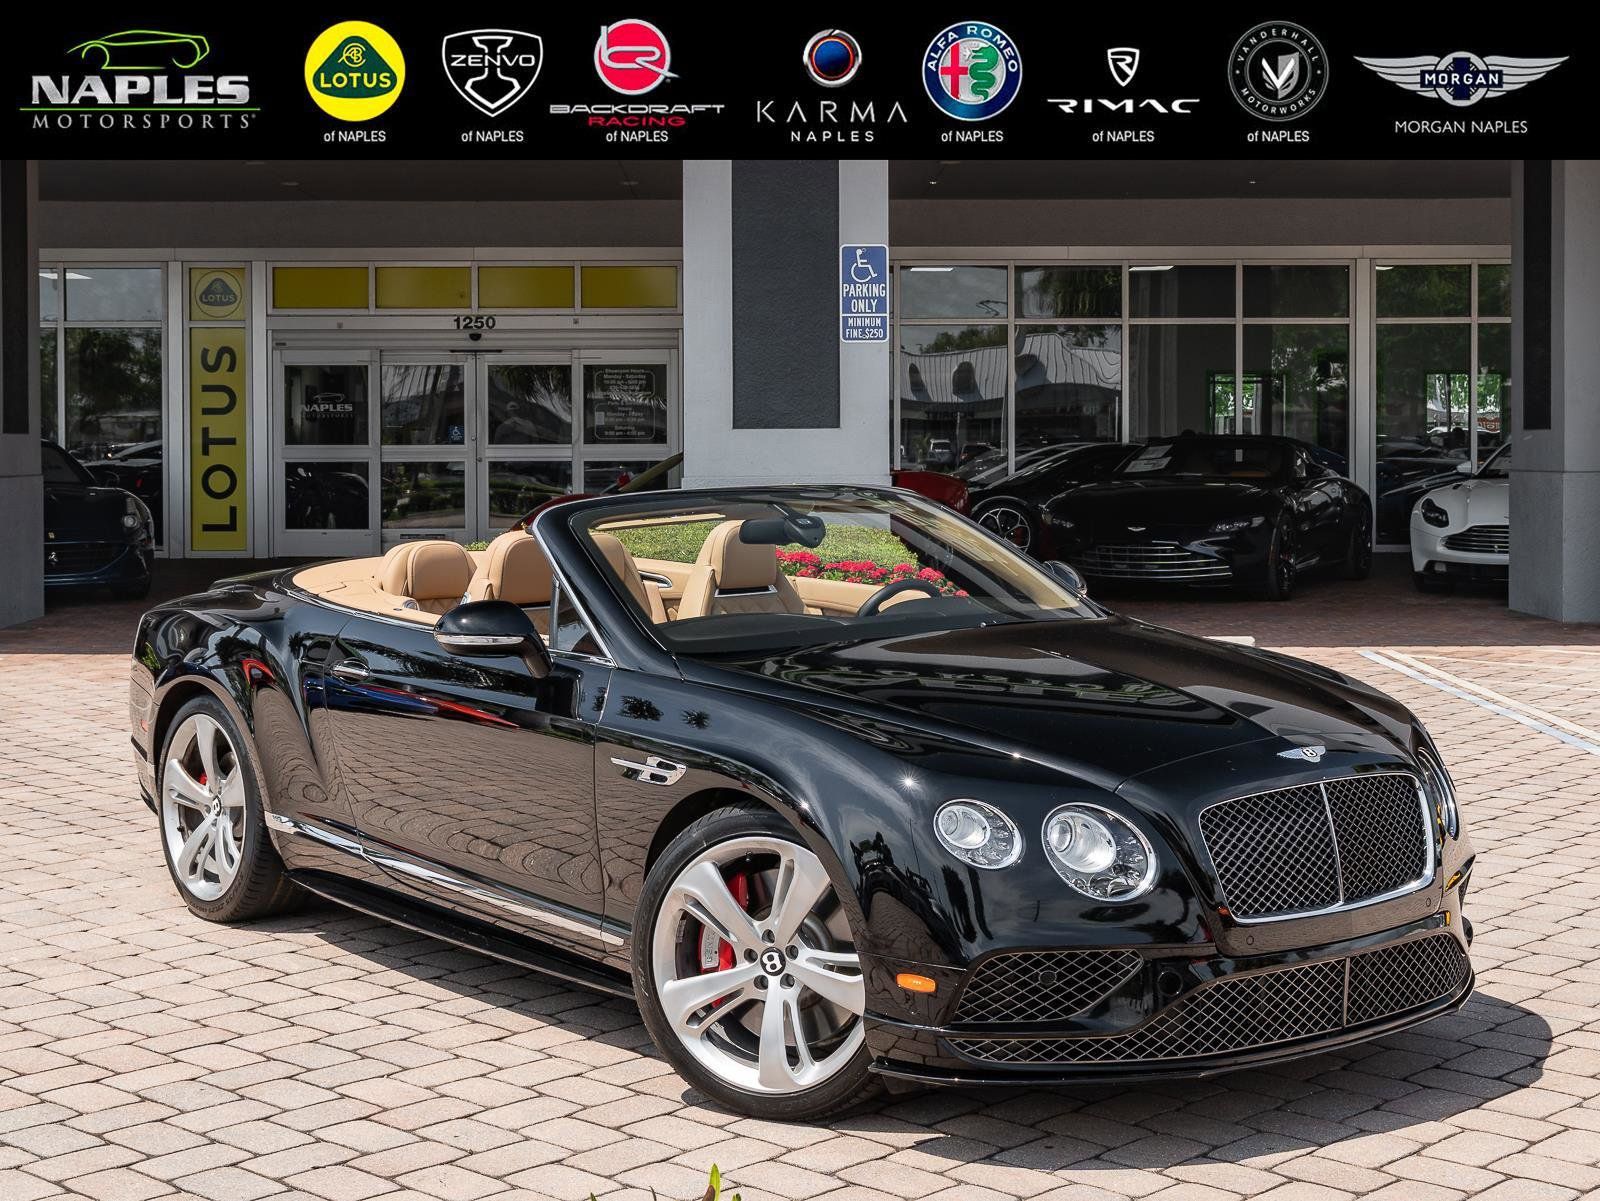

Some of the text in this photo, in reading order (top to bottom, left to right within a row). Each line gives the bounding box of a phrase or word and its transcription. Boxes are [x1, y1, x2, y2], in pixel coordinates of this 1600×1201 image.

[843, 284, 886, 297] PARKING
[201, 294, 234, 302] LOTUS
[851, 299, 877, 312] ONLY
[453, 315, 496, 329] 1250
[848, 317, 881, 327] MINIMUM
[846, 328, 884, 339] FINE $250
[301, 403, 353, 412] NAPLES
[201, 346, 237, 532] LOTUS
